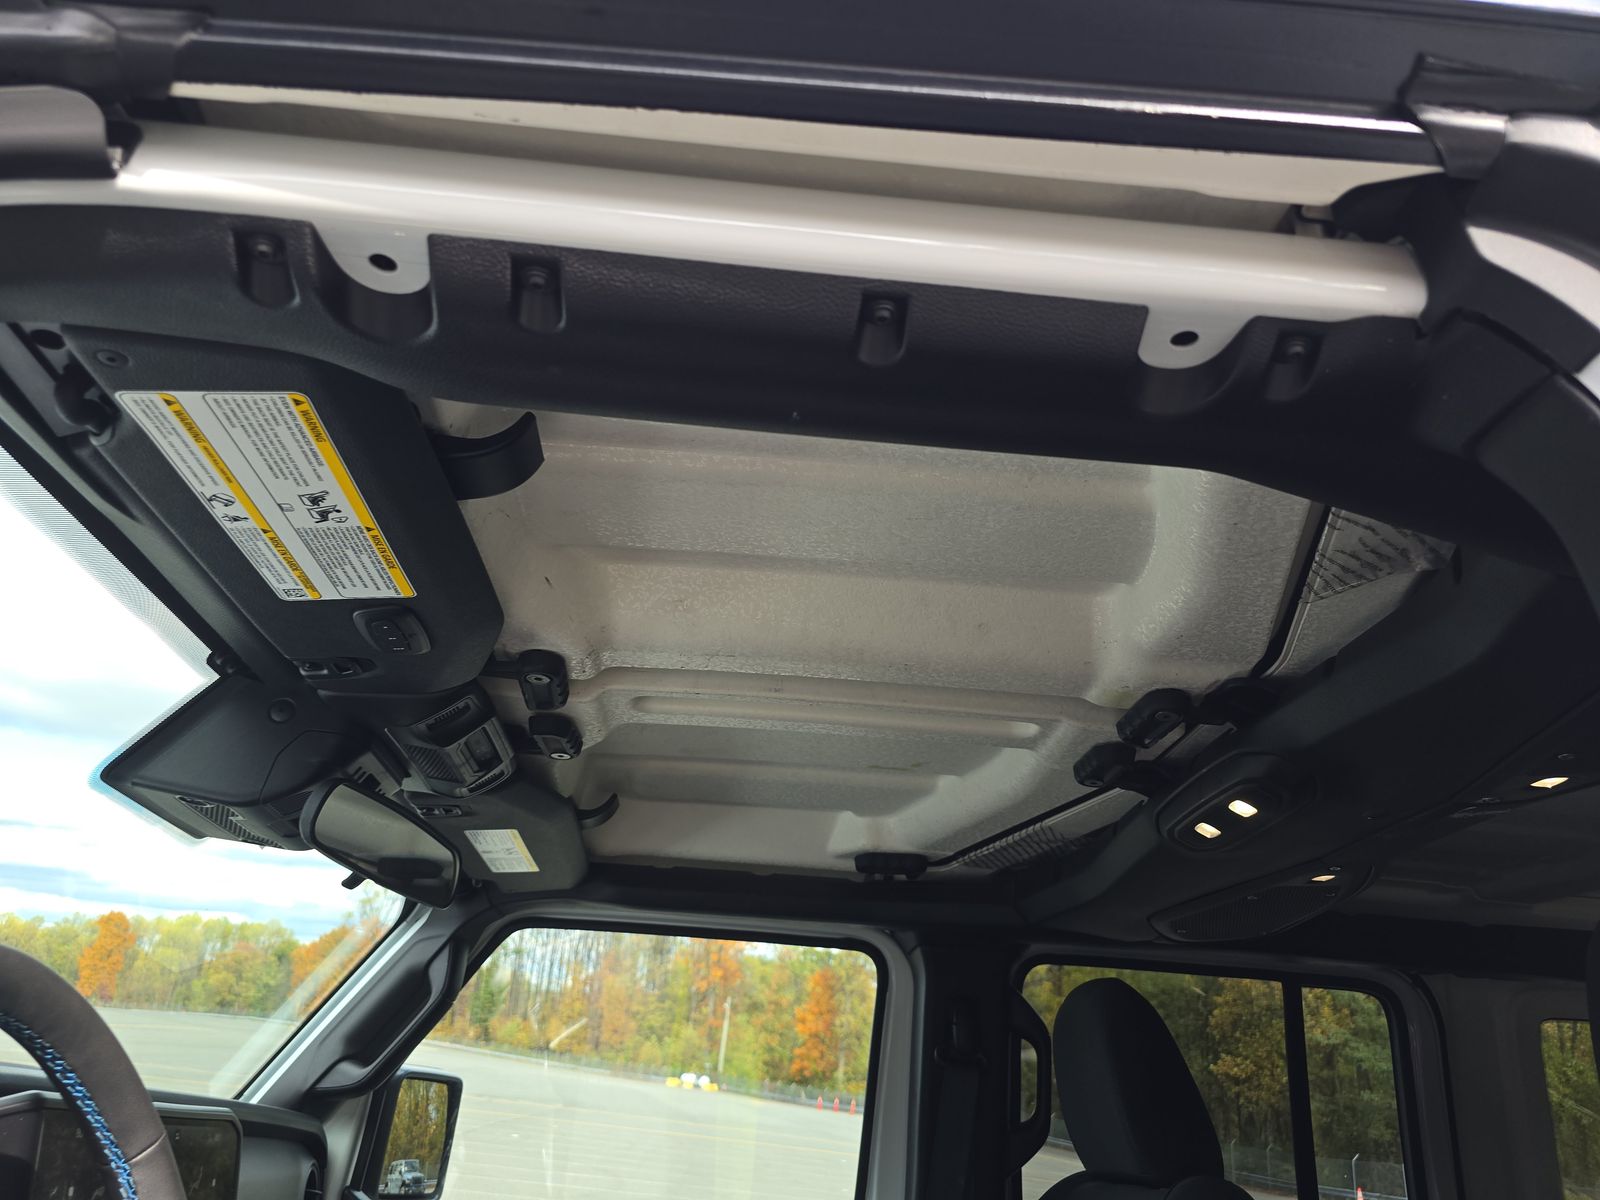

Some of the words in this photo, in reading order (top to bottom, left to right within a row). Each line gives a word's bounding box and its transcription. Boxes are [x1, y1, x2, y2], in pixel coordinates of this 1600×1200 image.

[172, 409, 207, 443] WARNING
[278, 396, 292, 409] EVEN
[286, 410, 300, 422] WITH
[293, 422, 313, 446] ADVANCED
[298, 409, 327, 442] WARNING
[266, 535, 284, 548] MISE
[276, 548, 290, 556] EN
[369, 534, 384, 546] MISE
[380, 553, 397, 569] GARDE
[281, 555, 301, 571] GARDE
